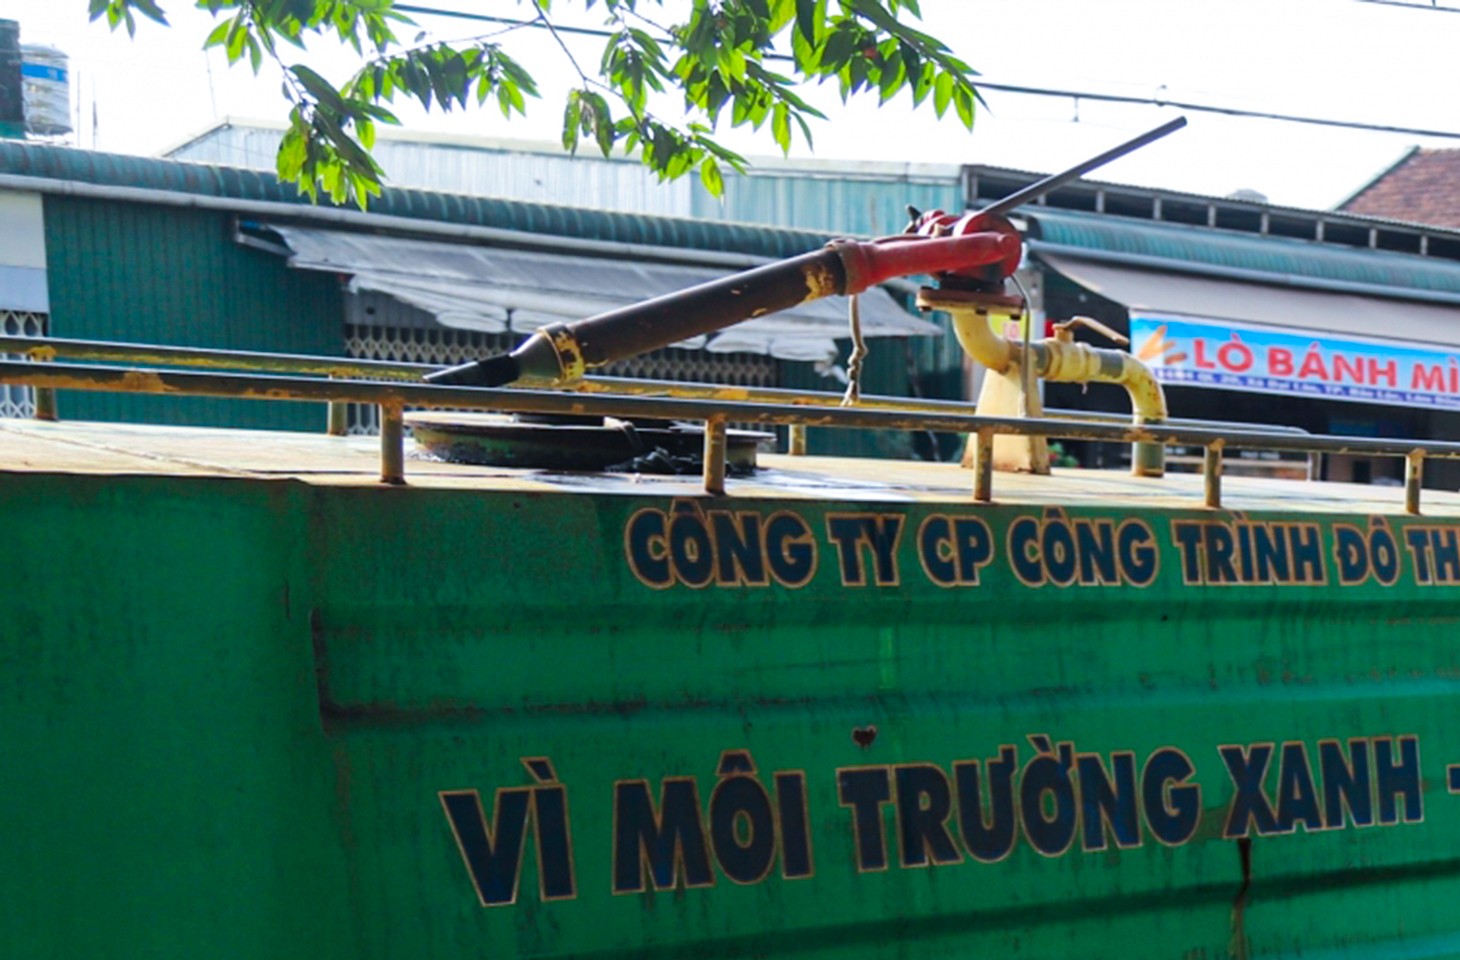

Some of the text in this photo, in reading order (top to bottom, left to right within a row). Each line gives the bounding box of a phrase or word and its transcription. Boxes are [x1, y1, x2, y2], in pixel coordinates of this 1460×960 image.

[1193, 332, 1254, 372] LÒ
[1266, 341, 1398, 387] BÁNH
[1411, 357, 1459, 393] MÌ
[625, 496, 818, 588] CÔNG
[826, 512, 905, 586] TY
[917, 512, 995, 587] CP
[1007, 505, 1160, 588] CÔNG
[1170, 509, 1328, 587] TRÌNH
[1331, 515, 1399, 587] ĐÔ
[438, 756, 577, 908] VÌ
[612, 748, 814, 896] MÔI
[836, 733, 1201, 873] TRƯỜNG
[1217, 735, 1424, 840] XANH
